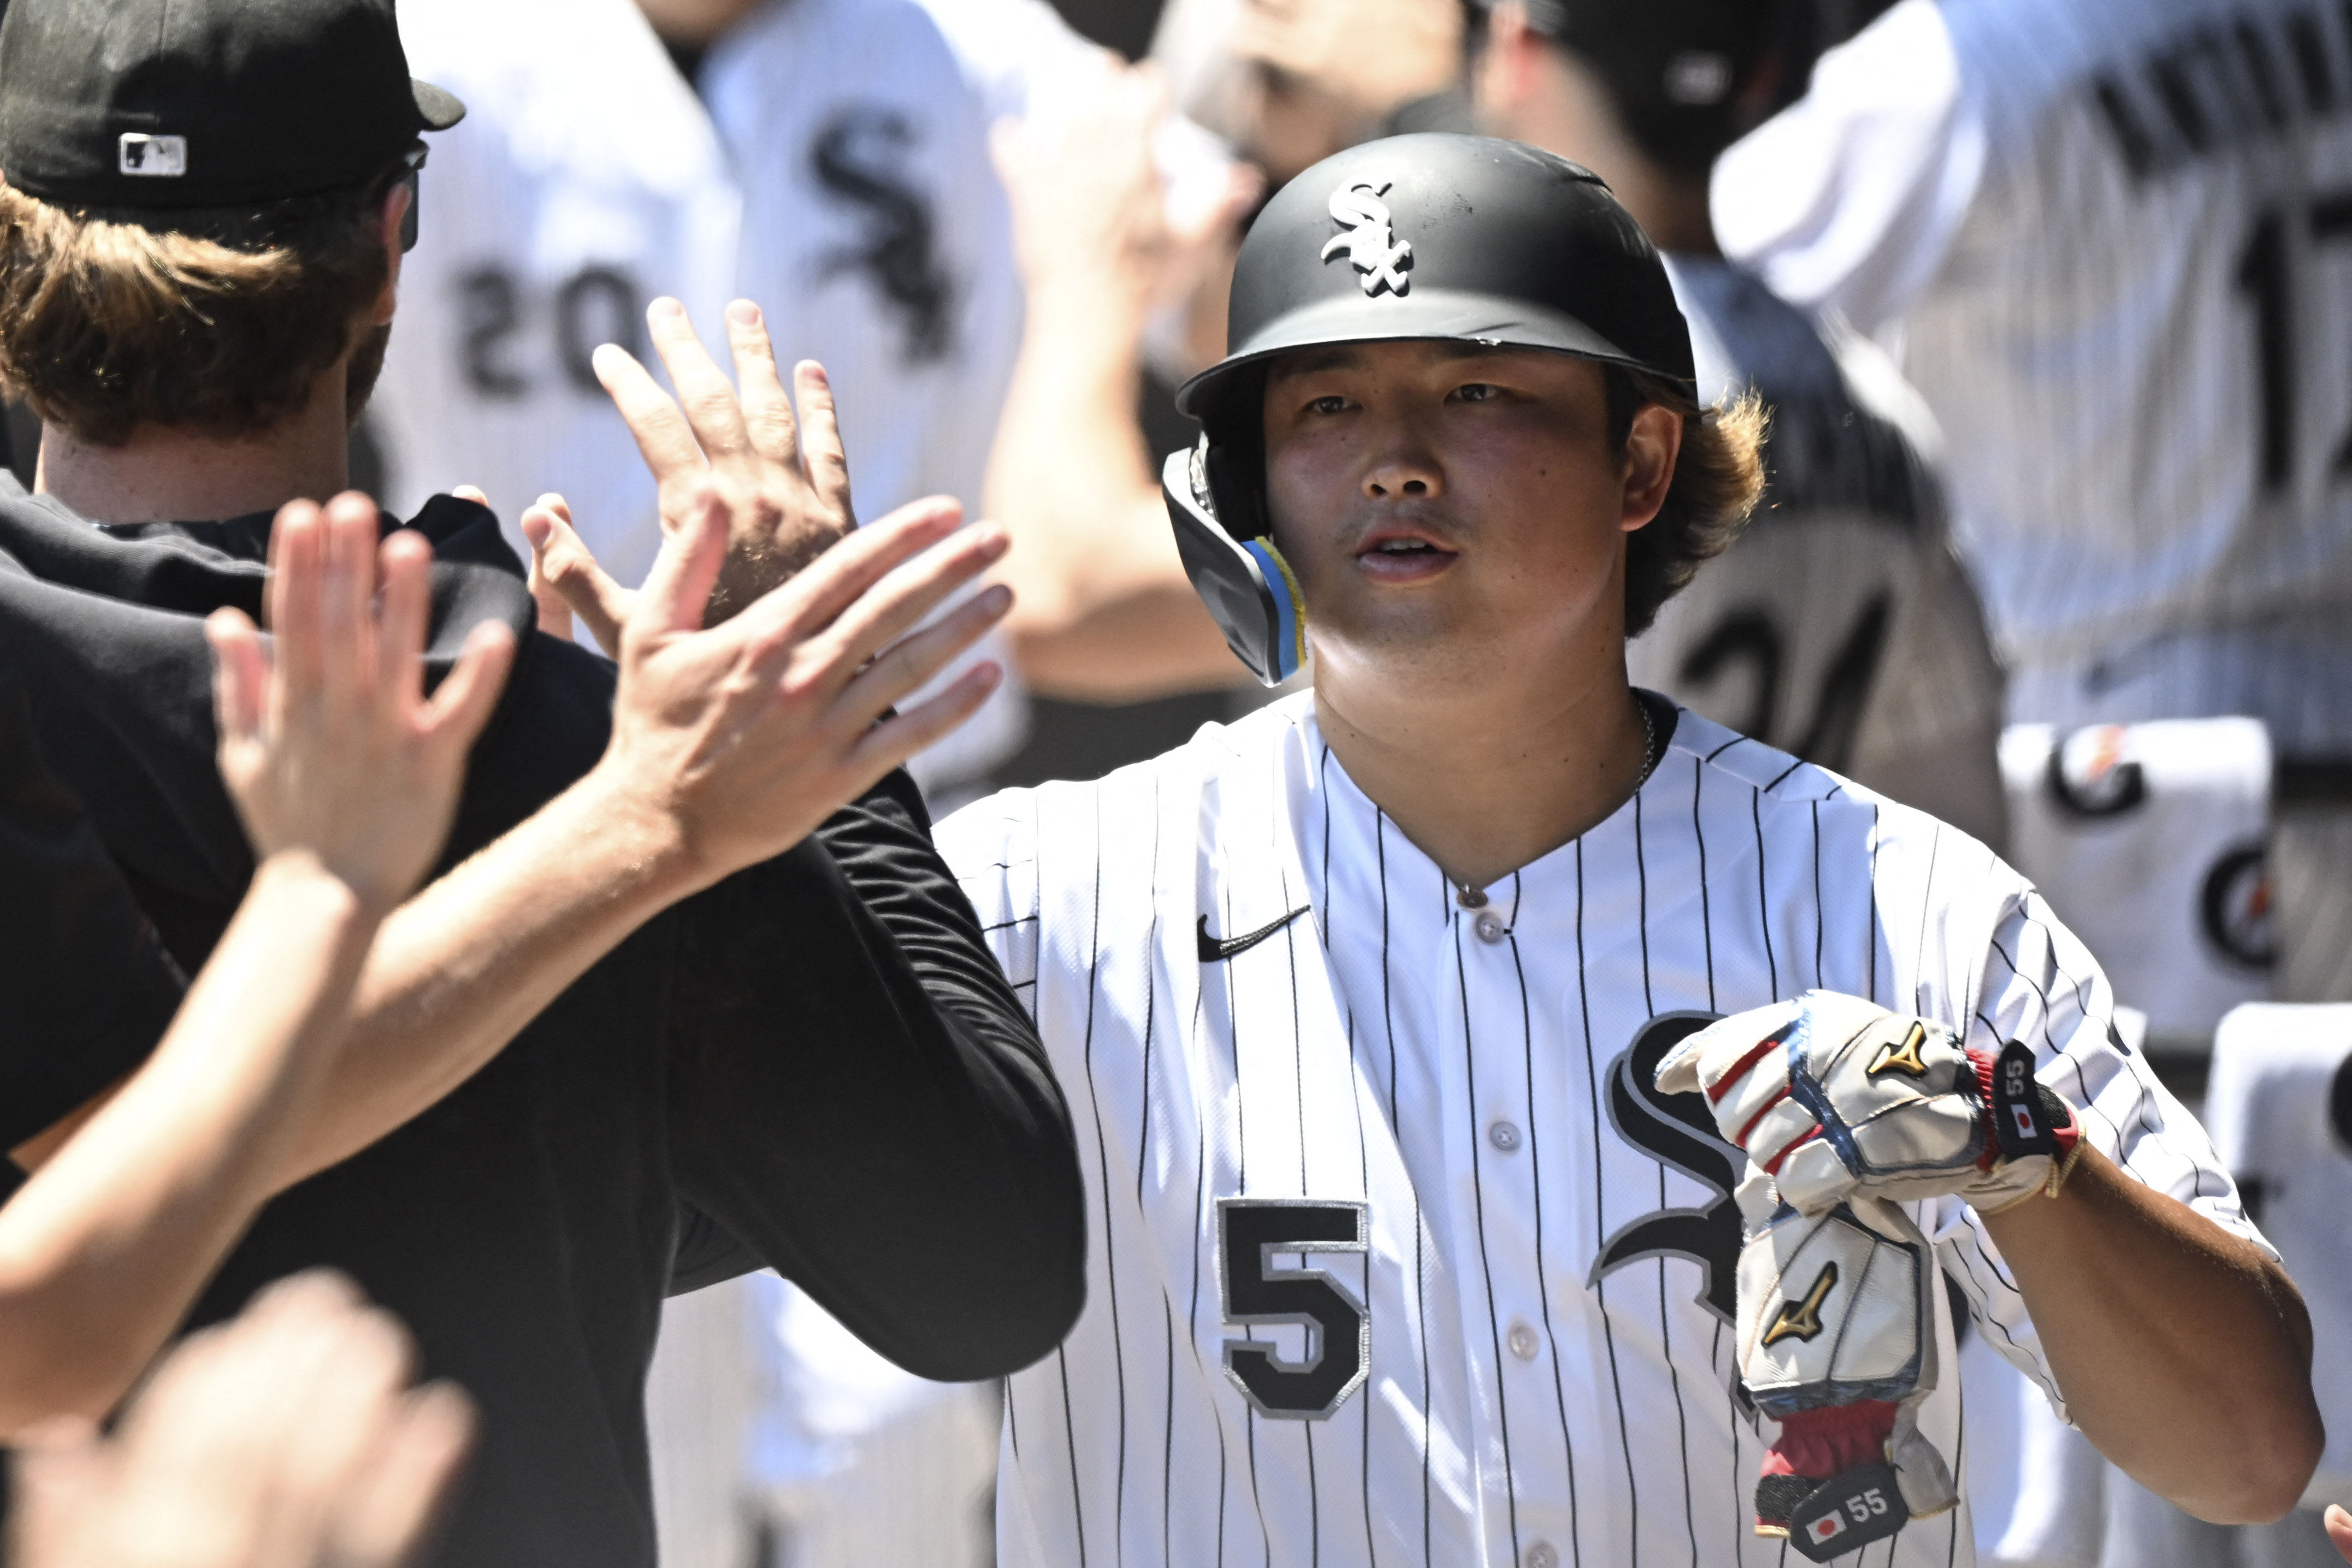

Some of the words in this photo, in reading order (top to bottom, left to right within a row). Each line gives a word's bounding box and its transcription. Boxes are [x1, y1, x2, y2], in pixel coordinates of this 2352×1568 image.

[2005, 1059, 2025, 1096] 55
[1216, 1198, 1370, 1421] 5
[1846, 1488, 1888, 1523] 55
